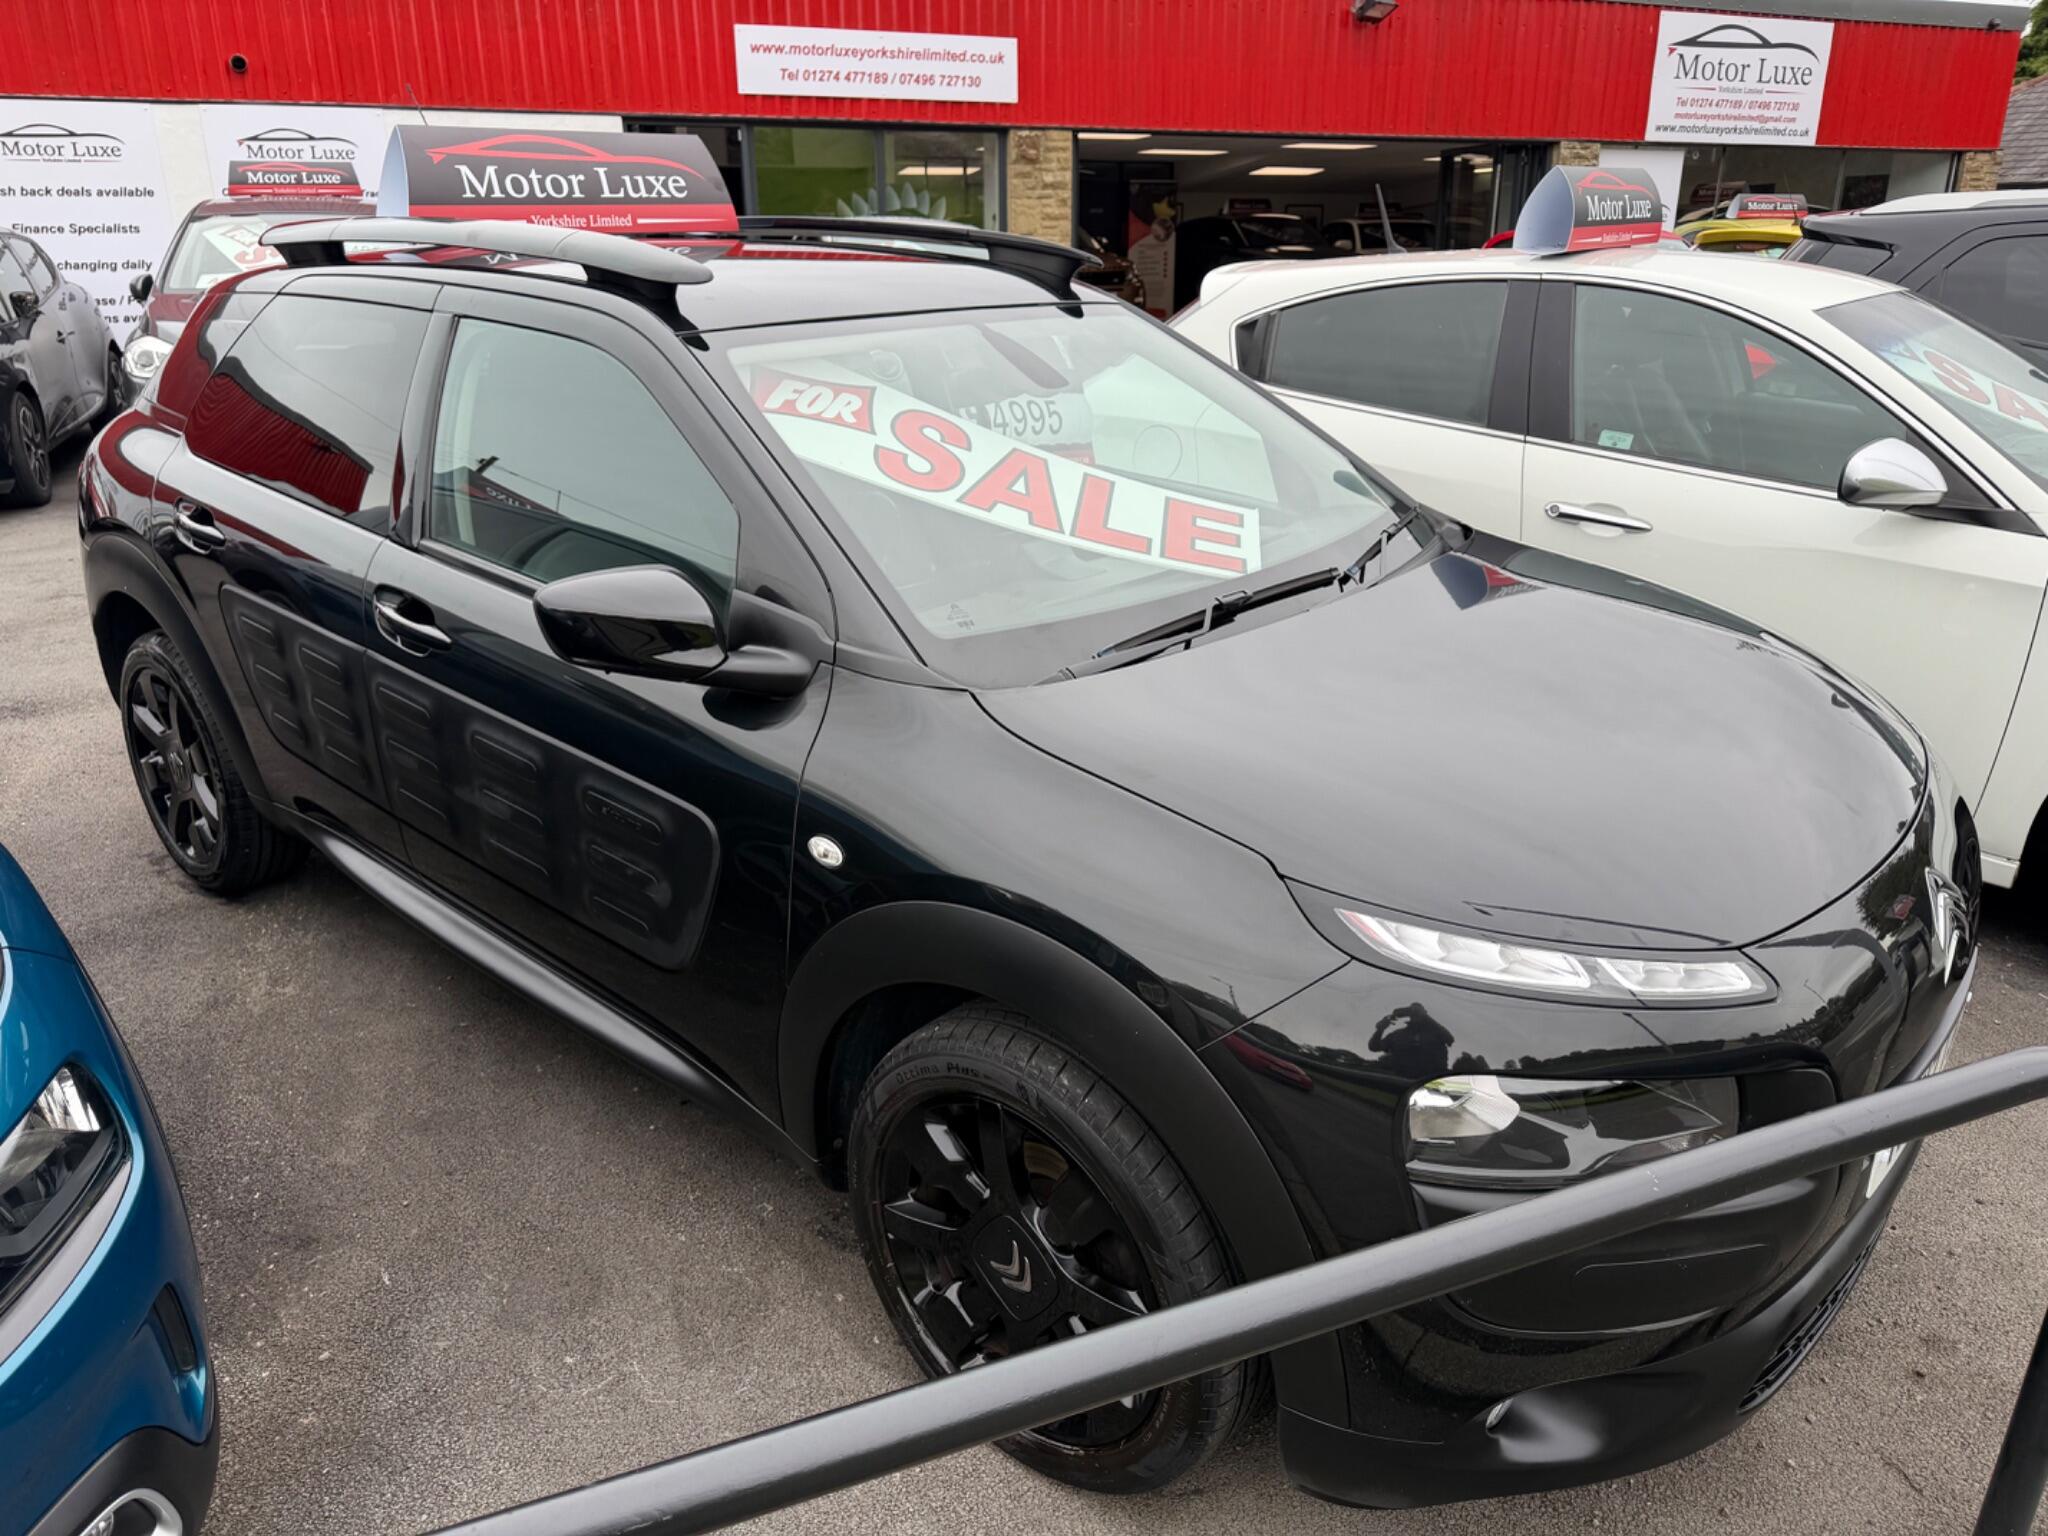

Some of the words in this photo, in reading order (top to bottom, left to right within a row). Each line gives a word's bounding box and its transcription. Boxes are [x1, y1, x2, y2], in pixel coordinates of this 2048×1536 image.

[750, 43, 1004, 65] www.motorluxeyorkshirelimited.co.uk
[1673, 53, 1750, 82] Motor
[1757, 58, 1812, 86] Luxe
[780, 68, 799, 81] Tel
[802, 69, 840, 82] 01274
[844, 71, 888, 84] 477189
[891, 73, 898, 85] /
[899, 73, 935, 86] 07496
[940, 75, 982, 88] 727130
[1676, 96, 1689, 107] Tel
[1690, 97, 1713, 108] 01274
[1715, 99, 1743, 109] 477189
[1773, 101, 1800, 112] 727130
[1655, 123, 1810, 138] www.motorluxeyorkshirelimited.co.uk
[1, 141, 65, 157] Motor
[71, 141, 122, 157] Luxe
[246, 144, 304, 160] Motor
[310, 145, 355, 160] Luxe
[246, 171, 297, 184] Motor
[301, 171, 341, 184] Luxe
[453, 164, 585, 199] Motor
[594, 166, 688, 199] Luxe
[20, 186, 52, 197] back
[57, 186, 92, 197] deals
[96, 187, 154, 197] available
[1586, 194, 1624, 222] Motor
[1625, 194, 1651, 219] Luxe
[1747, 202, 1774, 210] Motor
[530, 214, 588, 228] Yorkshire
[589, 214, 633, 227] Limited
[12, 223, 65, 234] Finance
[69, 223, 140, 236] Specialists
[57, 260, 117, 272] changing
[122, 260, 152, 272] daily
[763, 379, 863, 424] FOR
[873, 408, 1249, 575] SALE
[946, 1061, 980, 1078] Plus
